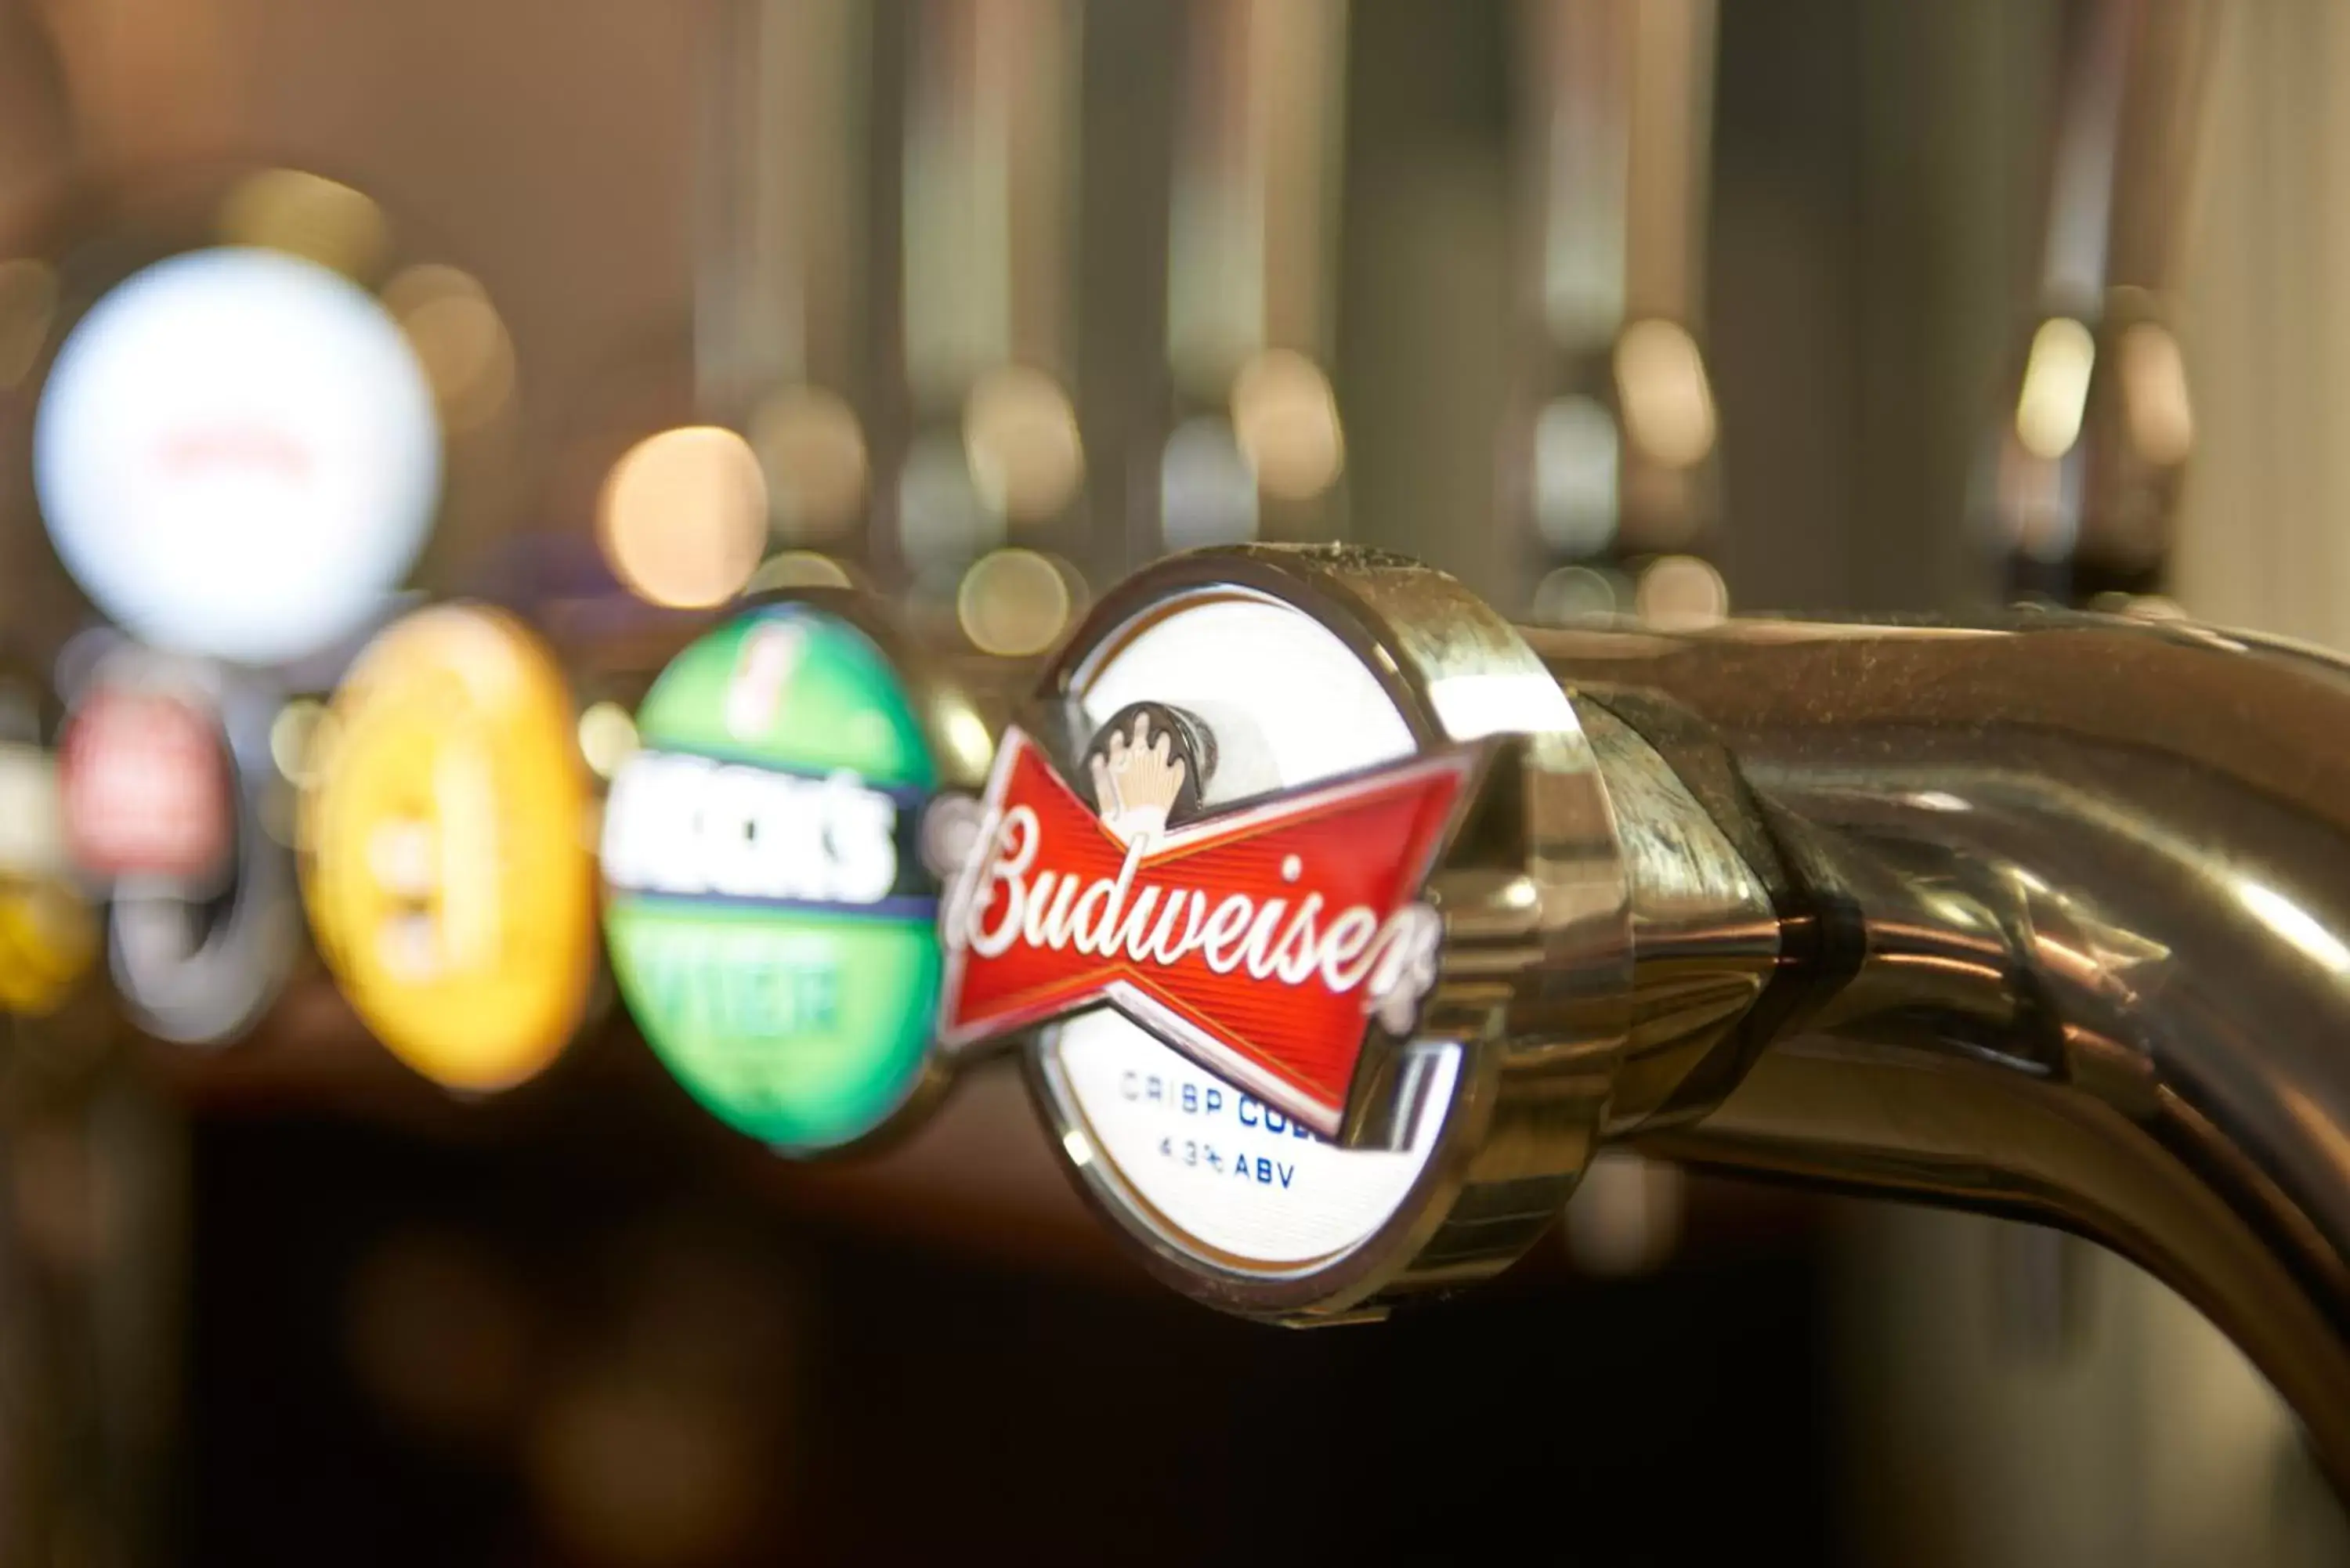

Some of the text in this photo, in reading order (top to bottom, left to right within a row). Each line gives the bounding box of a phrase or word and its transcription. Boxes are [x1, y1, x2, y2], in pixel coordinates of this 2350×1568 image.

[921, 791, 1442, 1035] Budweiser
[1238, 1093, 1321, 1143] CO
[1234, 1153, 1295, 1190] ABV
